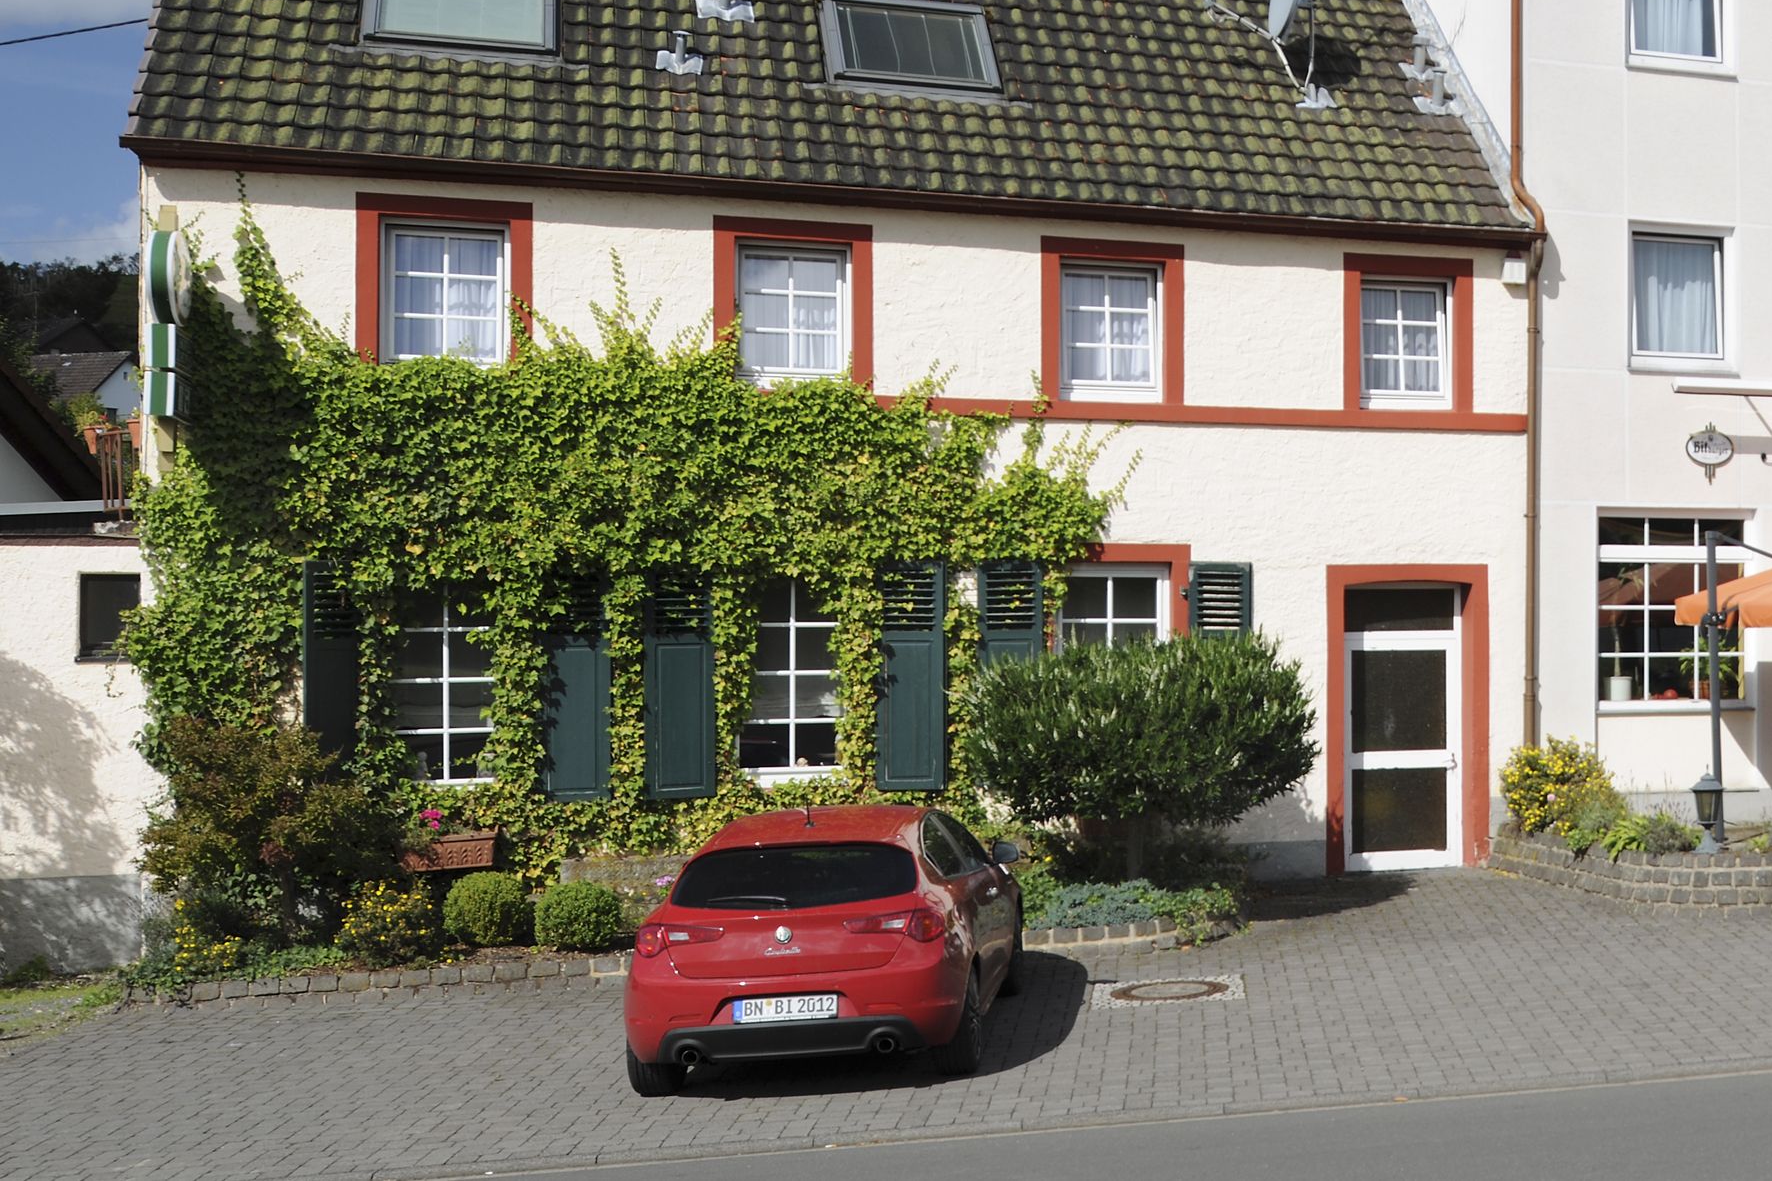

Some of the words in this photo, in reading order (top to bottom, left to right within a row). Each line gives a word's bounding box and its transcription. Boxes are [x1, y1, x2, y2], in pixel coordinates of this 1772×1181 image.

[744, 1000, 764, 1017] BN
[774, 999, 793, 1015] BI
[797, 996, 835, 1013] 2012
